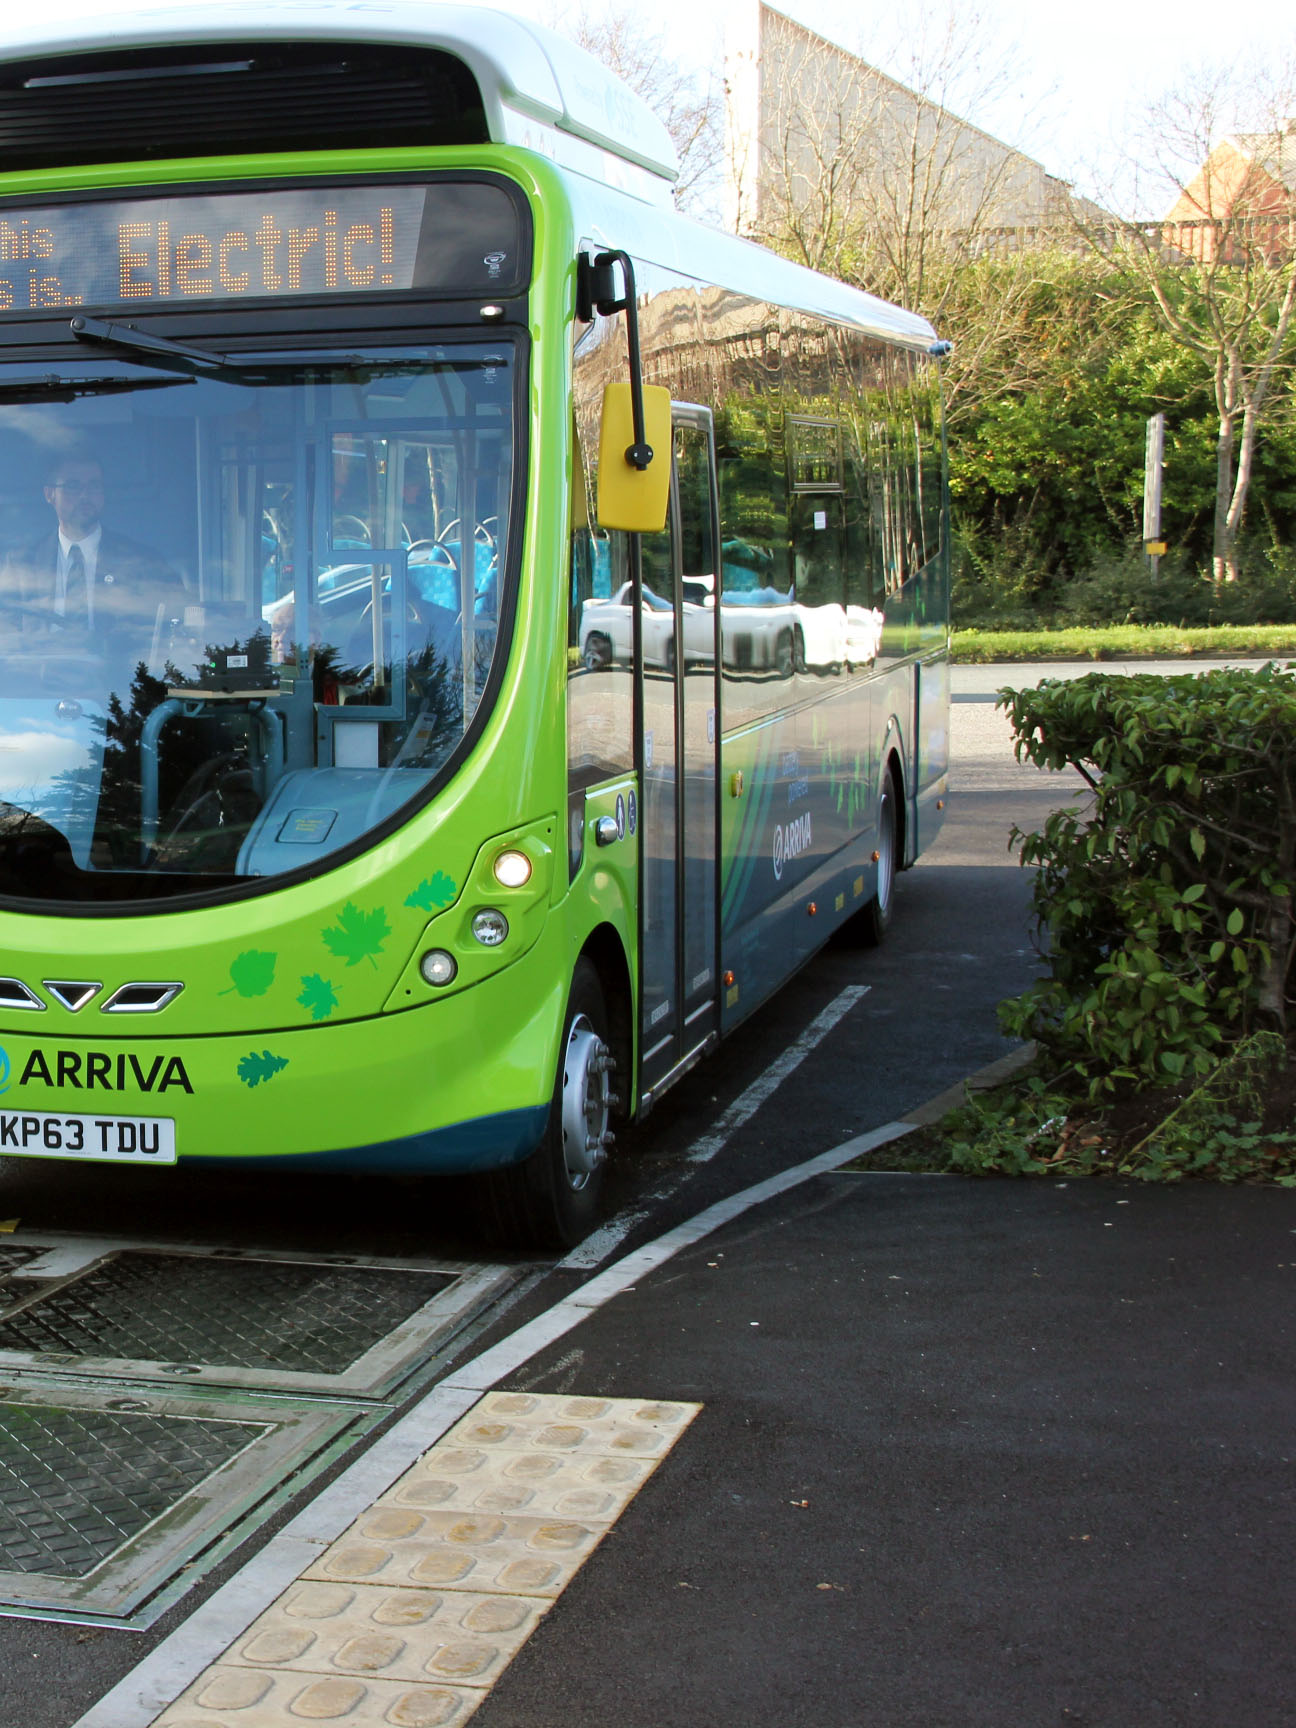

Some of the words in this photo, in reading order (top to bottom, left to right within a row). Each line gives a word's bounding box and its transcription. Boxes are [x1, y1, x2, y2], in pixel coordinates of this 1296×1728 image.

[118, 207, 394, 298] Electric!
[783, 811, 812, 862] ARRIVA
[18, 1048, 195, 1095] ARRIVA
[0, 1115, 84, 1151] KP63
[95, 1121, 159, 1154] TDU
